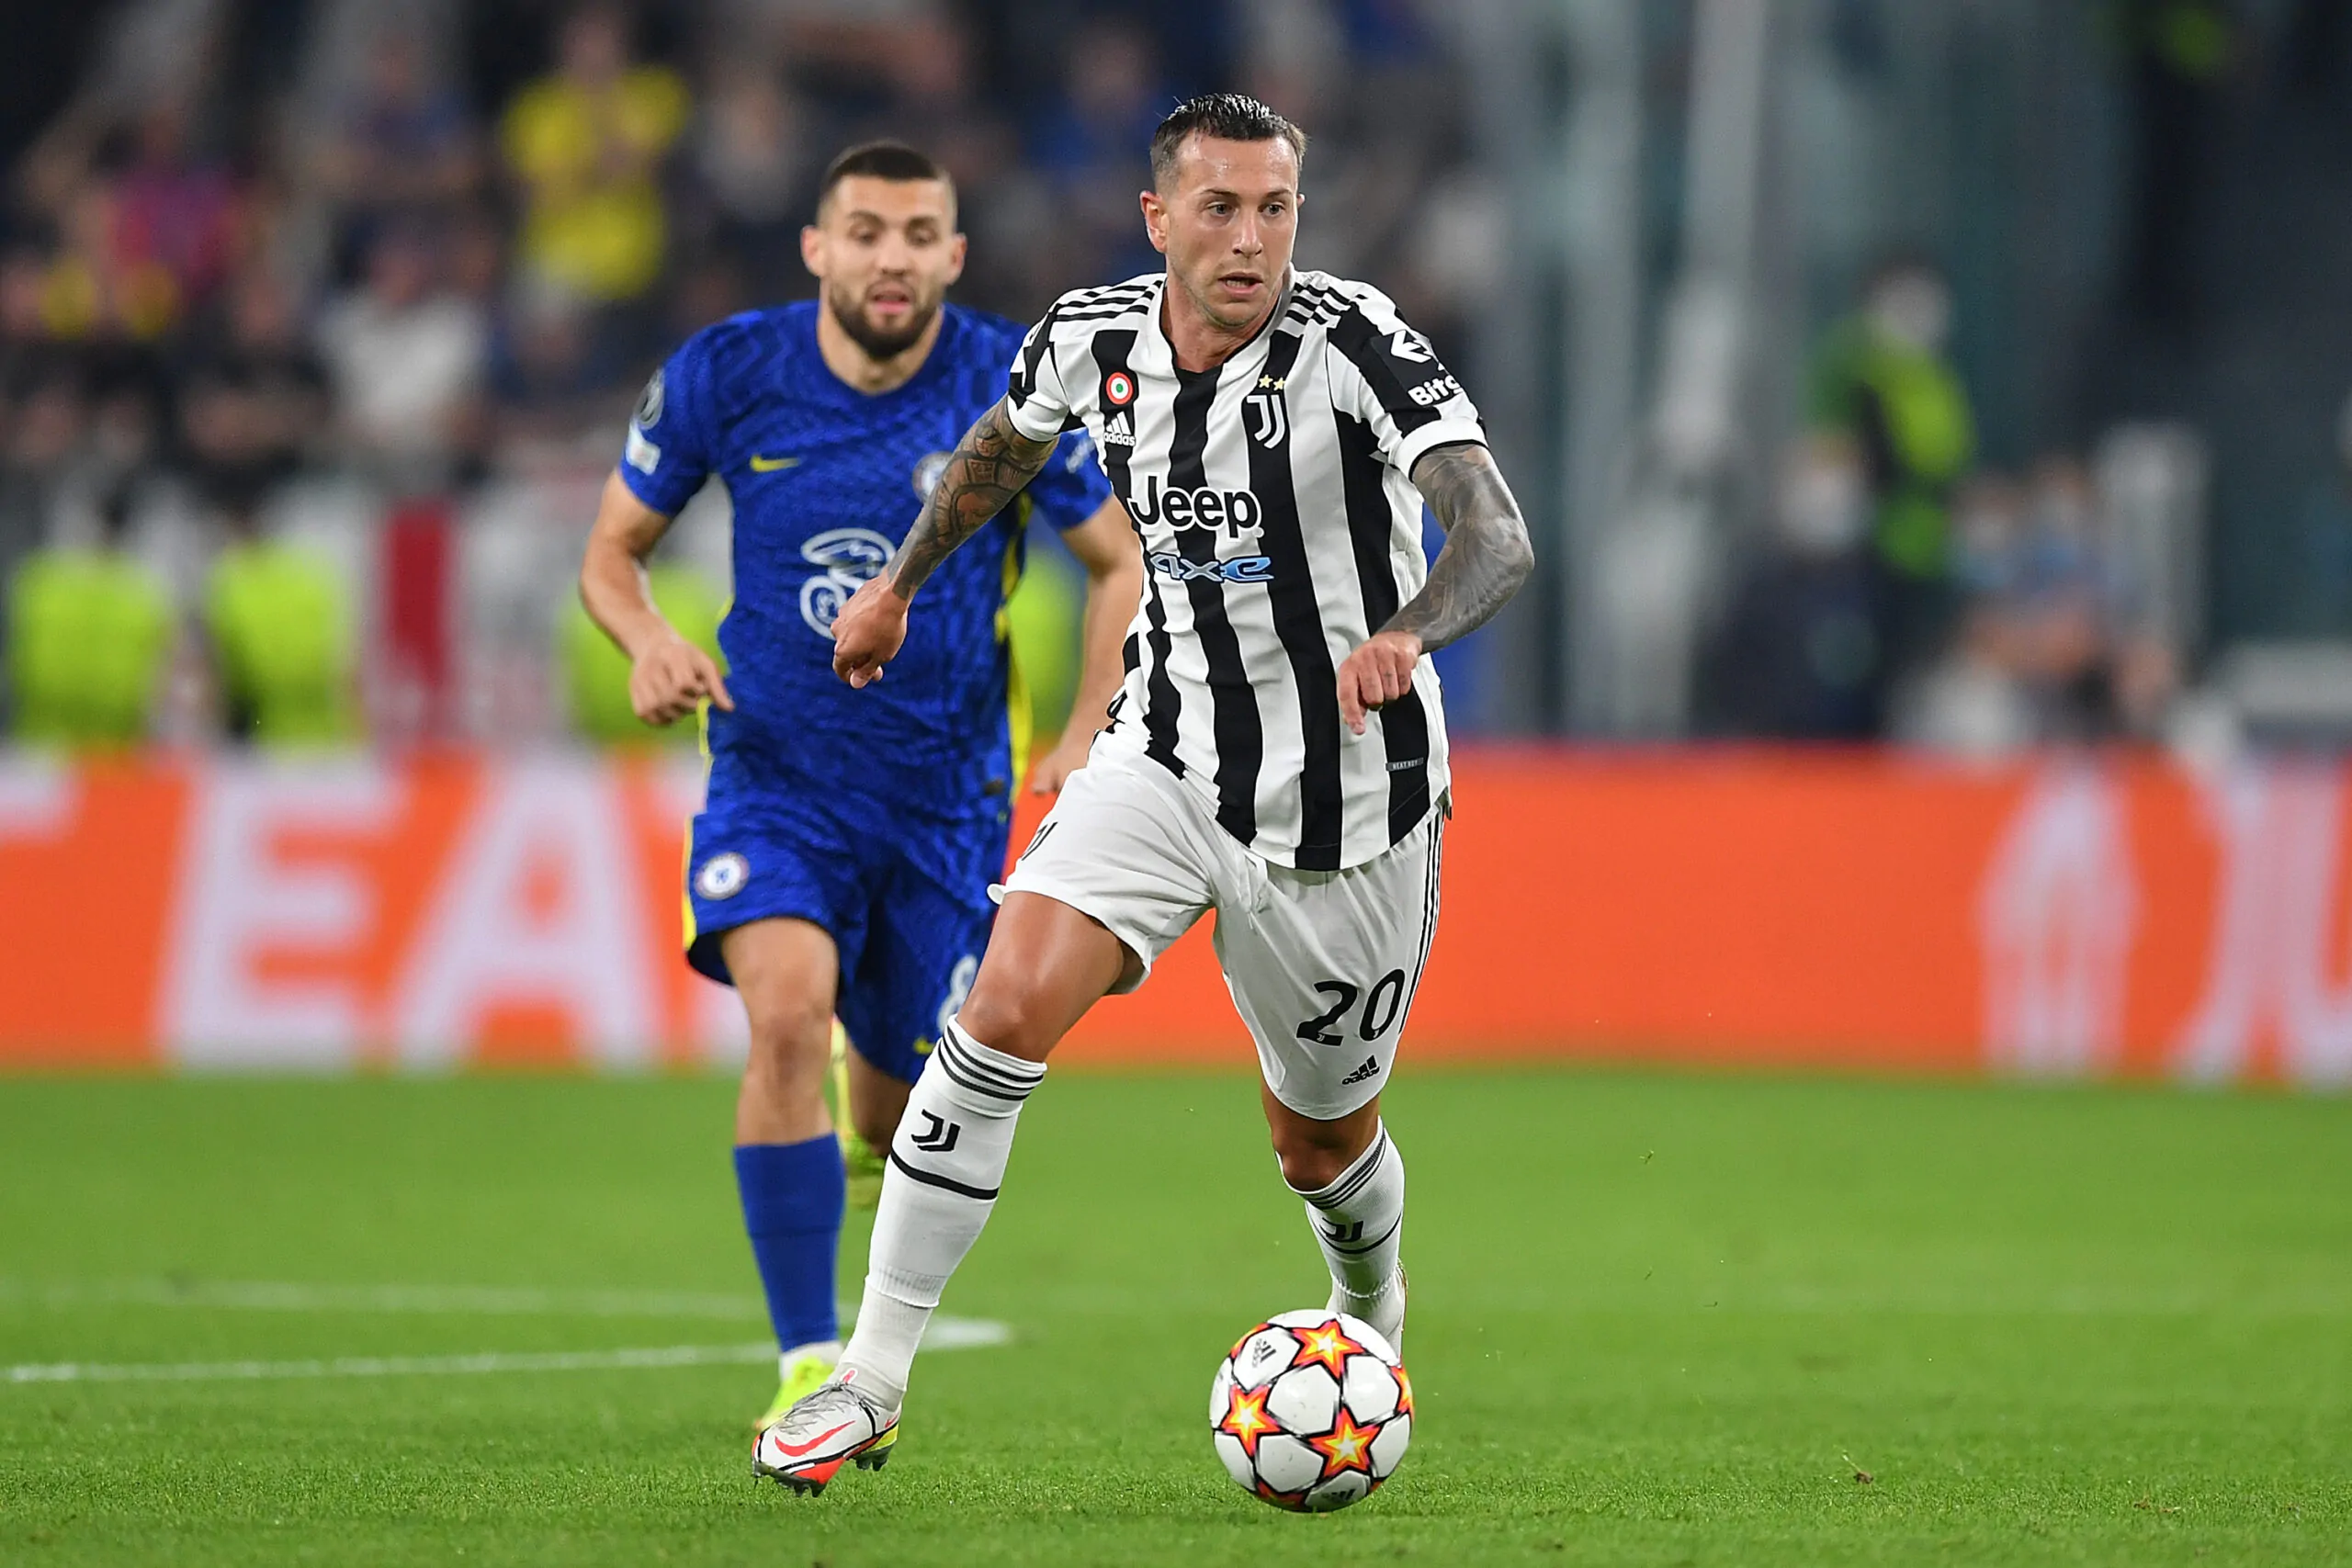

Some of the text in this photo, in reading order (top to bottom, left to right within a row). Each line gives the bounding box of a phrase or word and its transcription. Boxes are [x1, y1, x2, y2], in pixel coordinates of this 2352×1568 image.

[1103, 432, 1136, 446] adidas
[1129, 474, 1259, 539] Jeep
[1296, 969, 1405, 1046] 20
